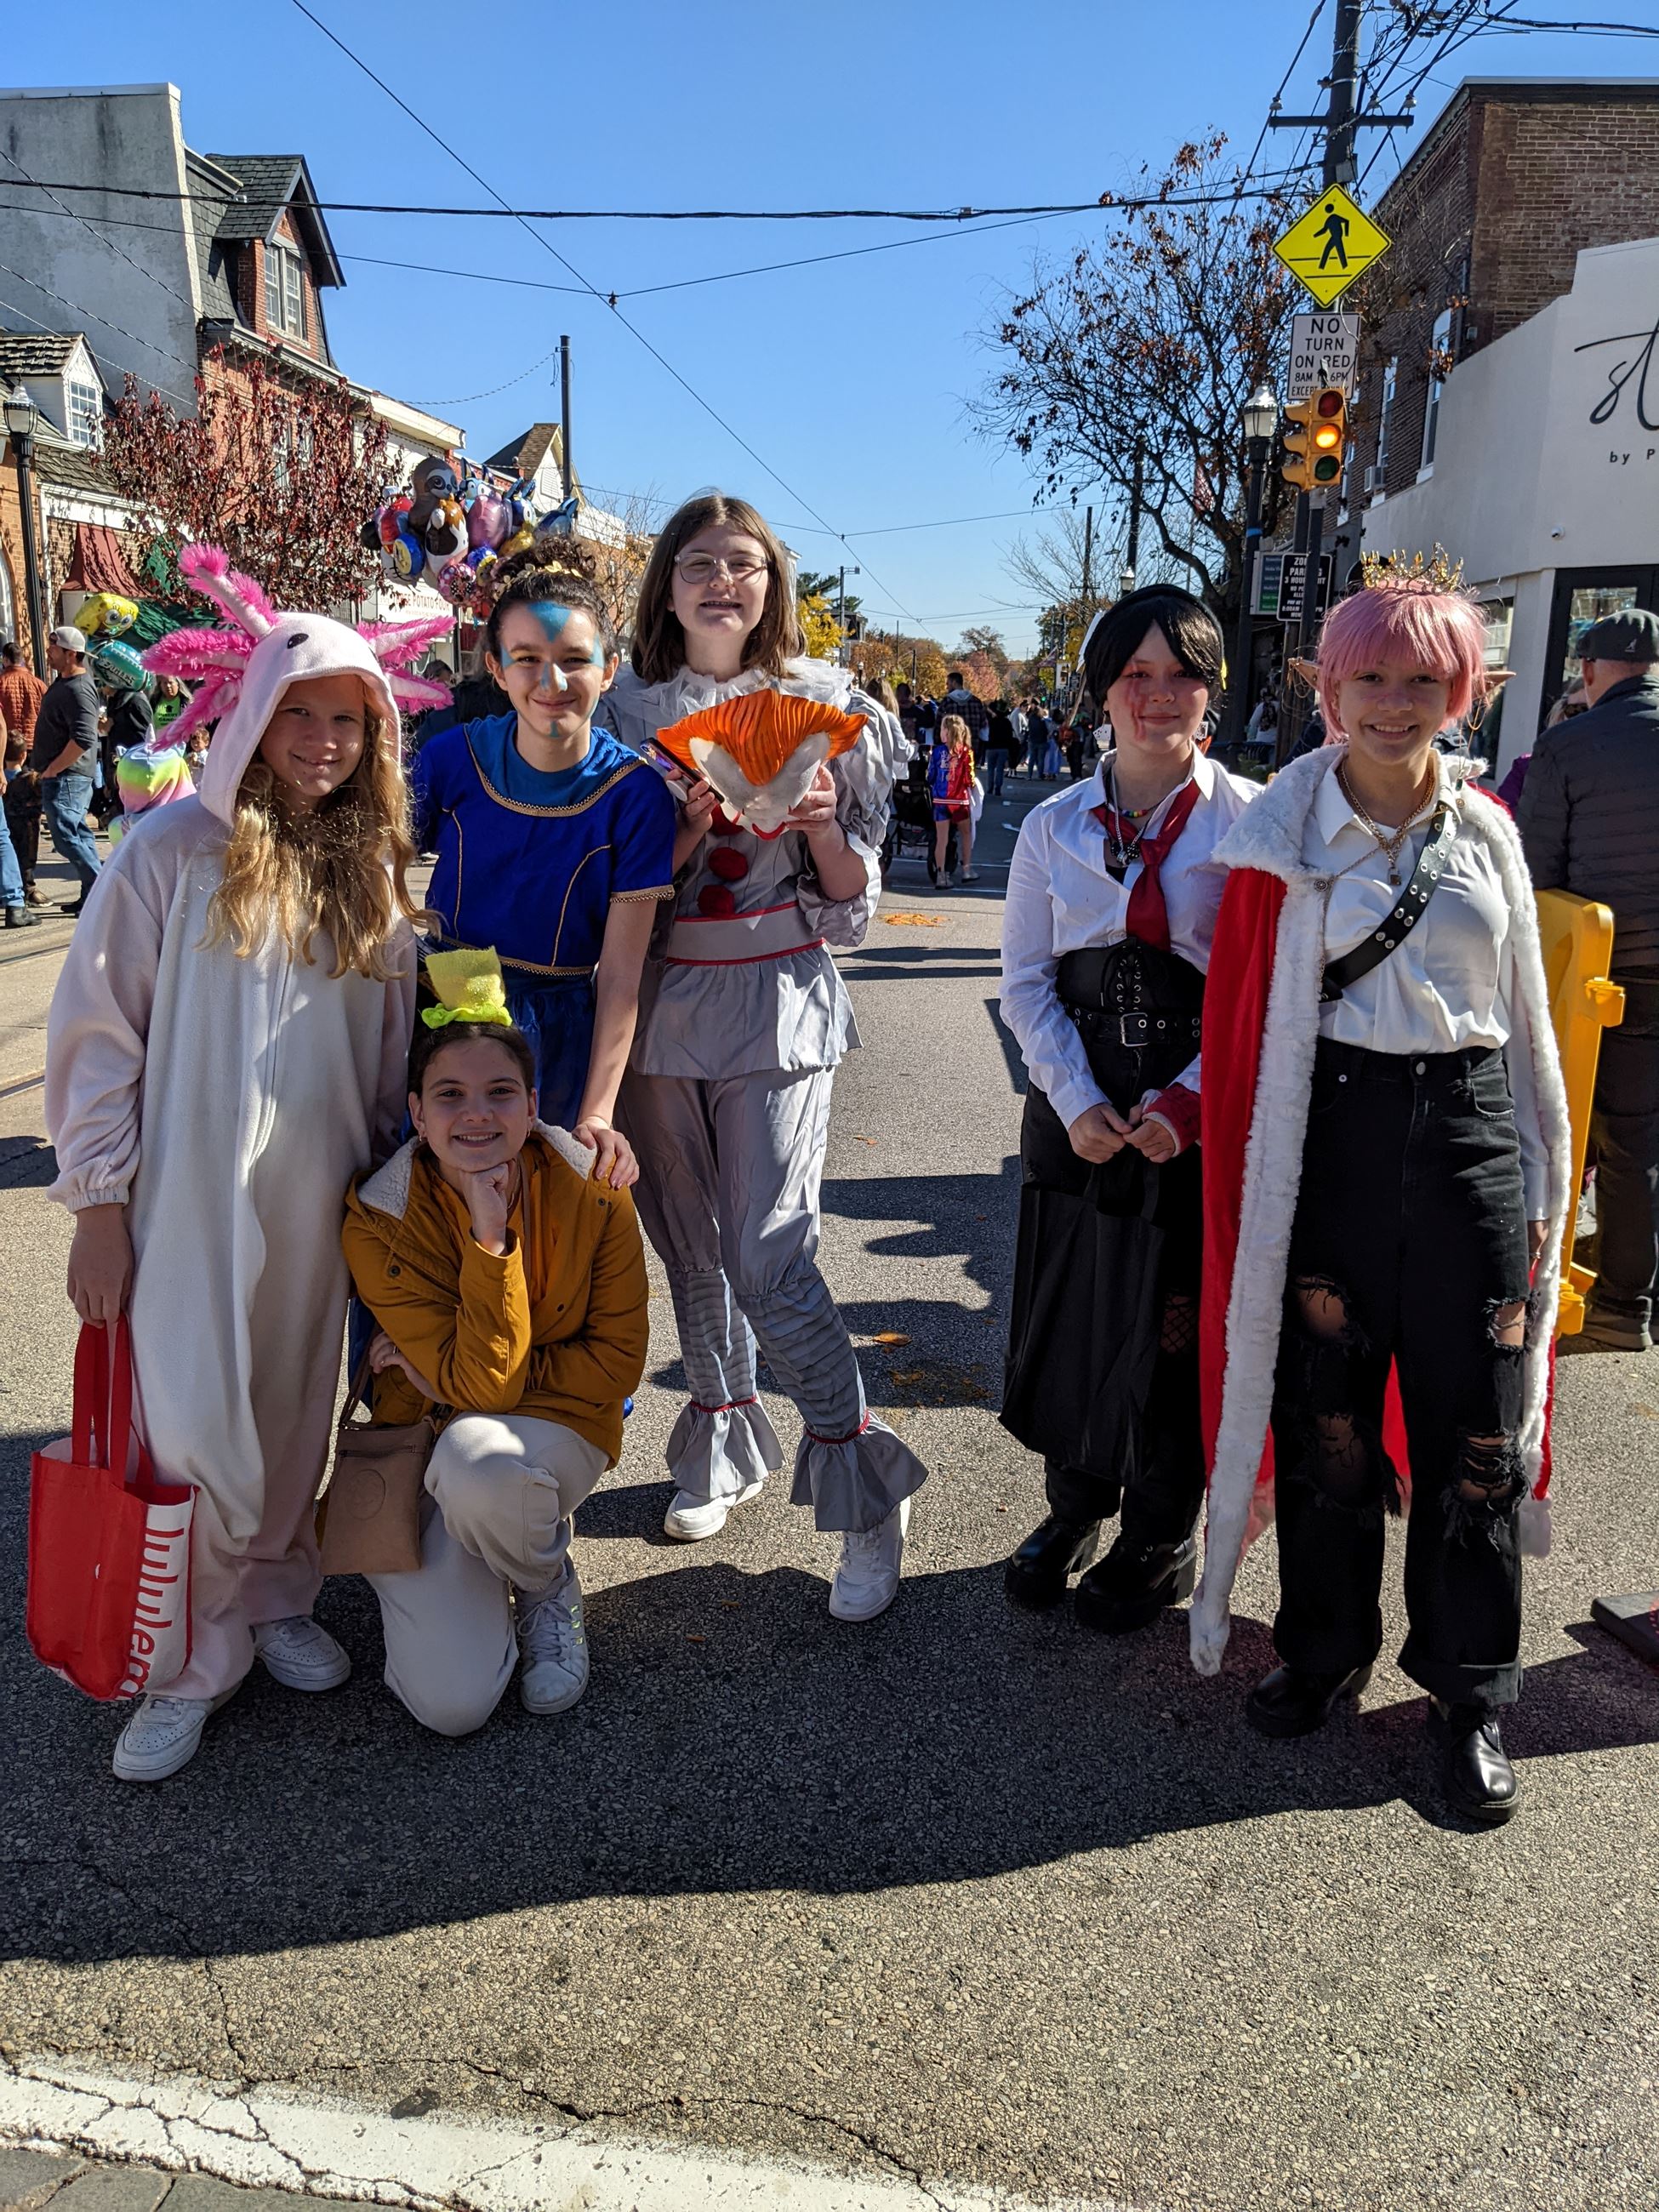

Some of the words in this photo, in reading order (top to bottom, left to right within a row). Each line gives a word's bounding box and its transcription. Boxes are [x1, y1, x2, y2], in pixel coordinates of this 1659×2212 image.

[1311, 317, 1340, 334] NO
[1305, 338, 1344, 351] TURN
[1295, 355, 1314, 368] ON
[1322, 355, 1350, 368] RED
[1295, 372, 1313, 382] 8AM
[1330, 372, 1348, 382] 6PM
[1610, 451, 1630, 465] by
[1646, 448, 1656, 460] P
[413, 594, 434, 609] POTATO
